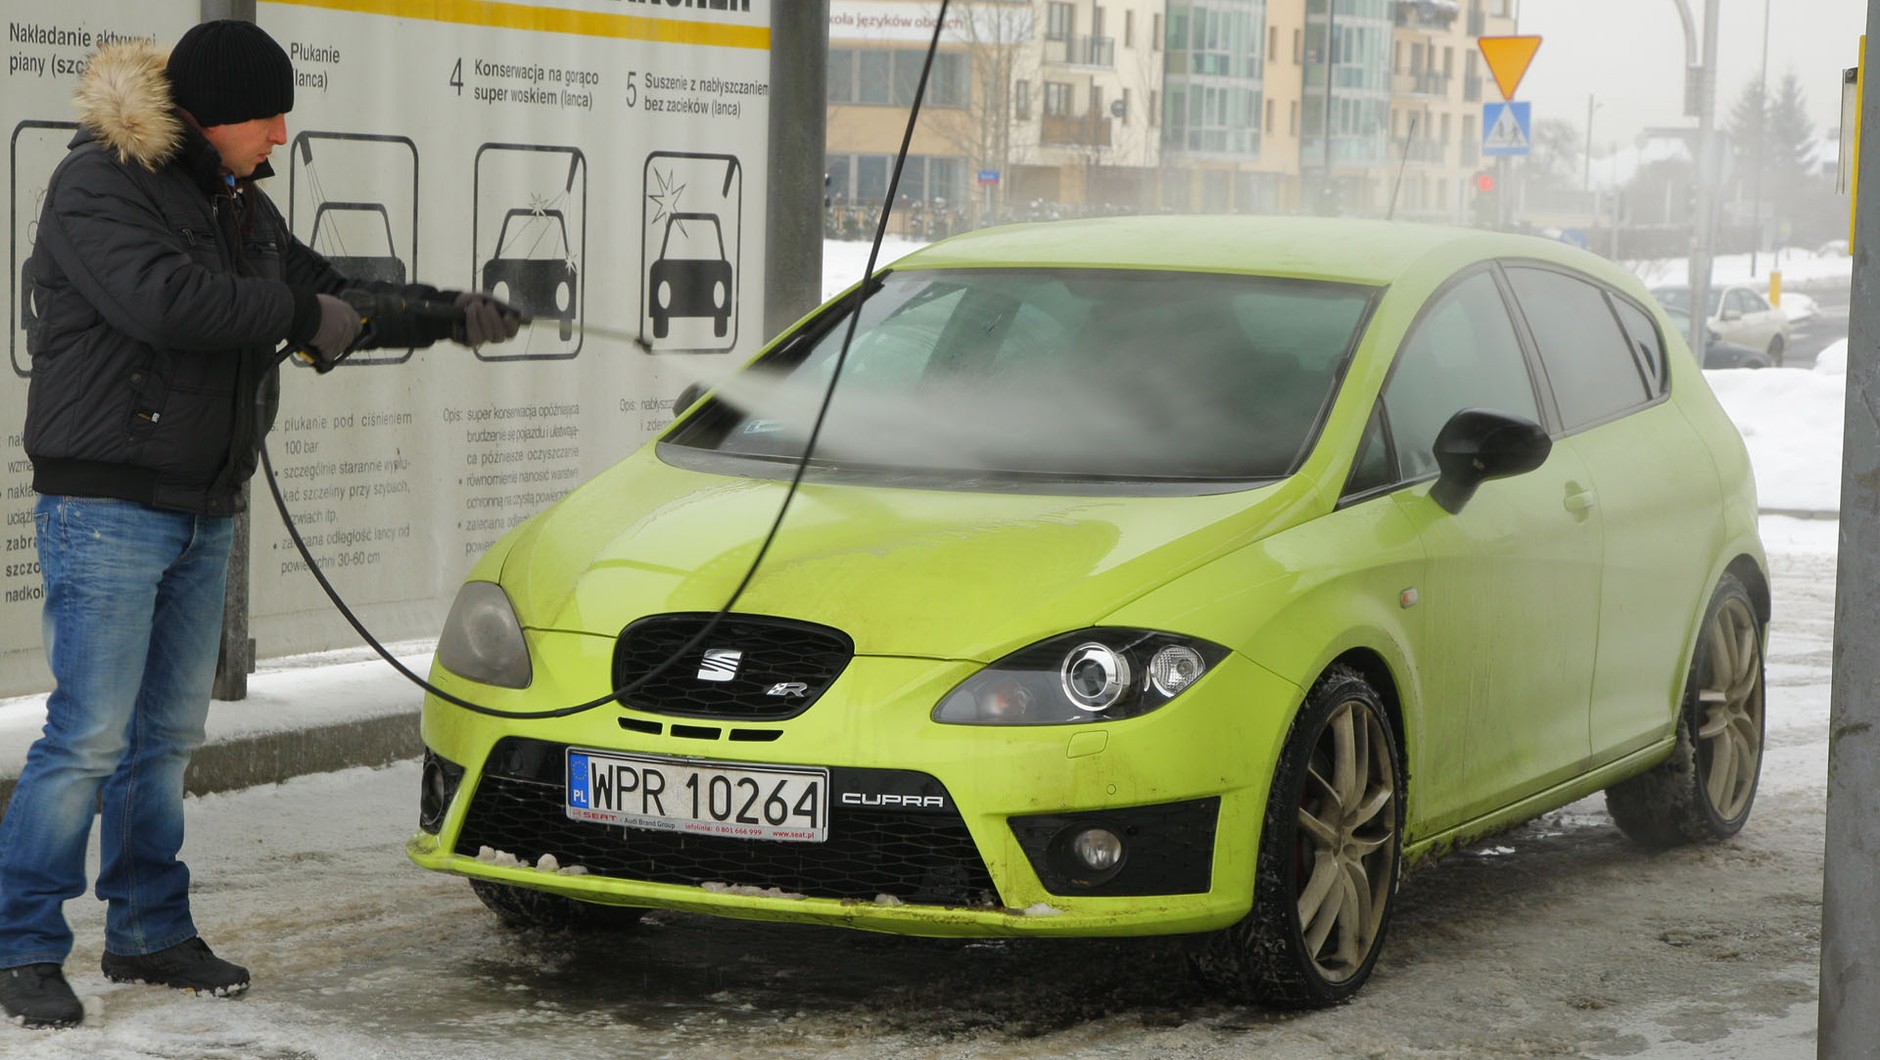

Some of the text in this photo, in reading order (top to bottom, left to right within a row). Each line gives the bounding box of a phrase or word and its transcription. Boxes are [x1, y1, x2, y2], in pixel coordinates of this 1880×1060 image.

[856, 12, 912, 28] języków
[915, 15, 964, 31] obcch
[10, 22, 91, 47] Nakładanie
[10, 52, 88, 78] piany (szc
[291, 42, 340, 64] Płukanie
[294, 68, 328, 93] lanca)
[450, 57, 464, 96] 4
[475, 59, 599, 88] Konserwacja na gorąco
[645, 72, 688, 91] Suszenie
[690, 78, 696, 91] z
[474, 86, 593, 111] super woskiem (lanca)
[626, 71, 637, 108] 5
[644, 96, 741, 118] bez zacieków (lanca)
[284, 416, 327, 433] płukanie
[333, 413, 354, 430] pod
[361, 411, 412, 427] ciśnieniem
[467, 407, 491, 422] super
[285, 440, 319, 455] 100 bar
[349, 485, 371, 500] przy
[281, 555, 335, 575] powiechni
[338, 551, 365, 567] 30-60
[573, 762, 818, 829] PL WPR 10264
[842, 792, 944, 808] CUPRA
[583, 811, 618, 822] SEAT
[624, 817, 637, 825] Audi
[638, 818, 657, 827] Brand
[657, 820, 676, 830] Group
[721, 826, 733, 834] 801
[735, 827, 748, 835] 666
[750, 828, 762, 836] 999
[772, 829, 816, 839] www.seat.pl
